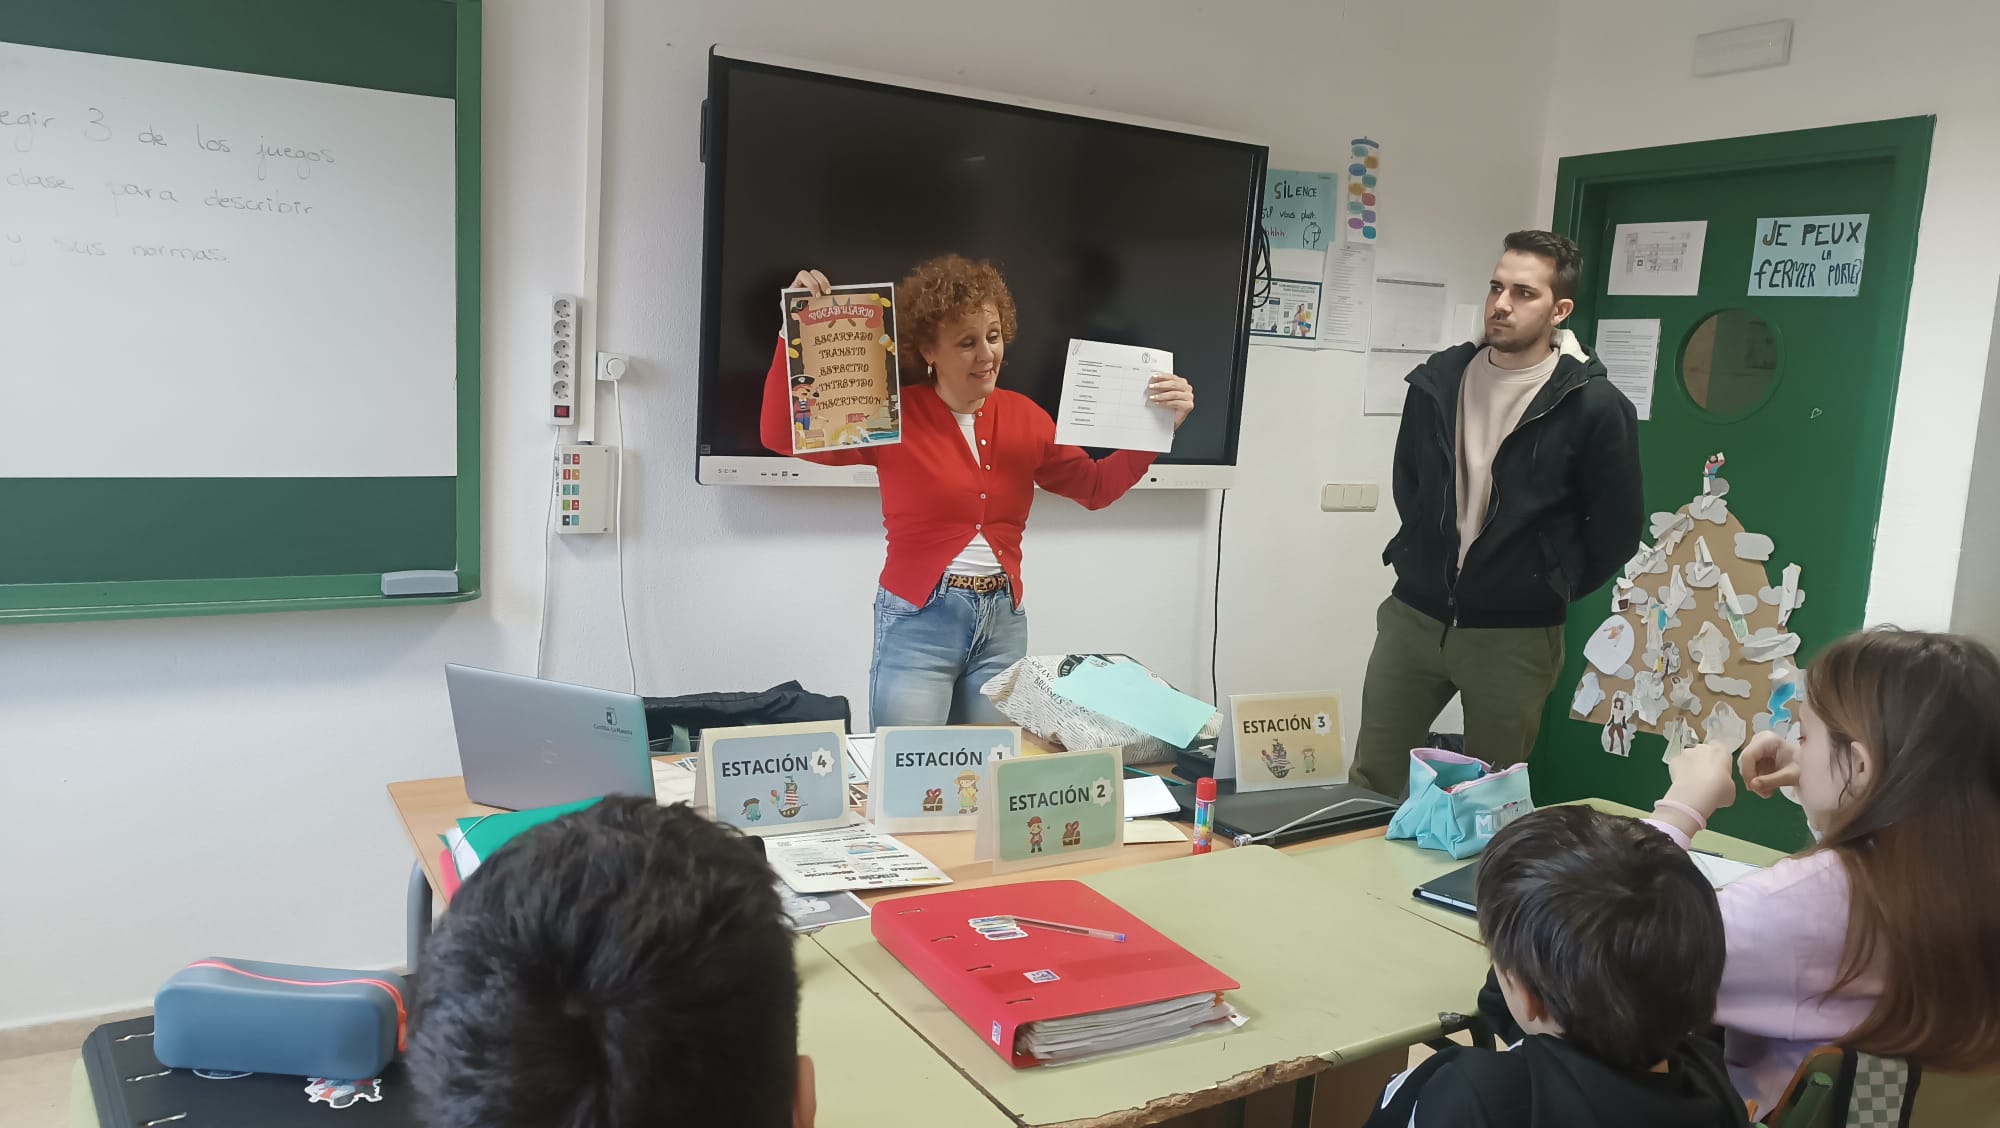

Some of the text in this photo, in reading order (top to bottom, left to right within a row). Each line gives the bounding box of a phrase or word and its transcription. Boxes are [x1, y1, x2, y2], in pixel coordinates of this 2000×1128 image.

[84, 107, 113, 142] 3
[138, 125, 168, 147] de
[196, 123, 232, 154] los
[256, 135, 336, 181] juegos
[106, 181, 179, 217] para
[204, 188, 314, 215] describir
[1762, 220, 1862, 246] JE PEUX
[1821, 249, 1832, 260] LA
[1243, 713, 1326, 735] ESTACIÓN 3
[722, 752, 827, 778] ESTACIÓN 4
[895, 747, 1003, 768] ESTACIÓN 1
[1009, 782, 1106, 813] ESTACIÓN 2
